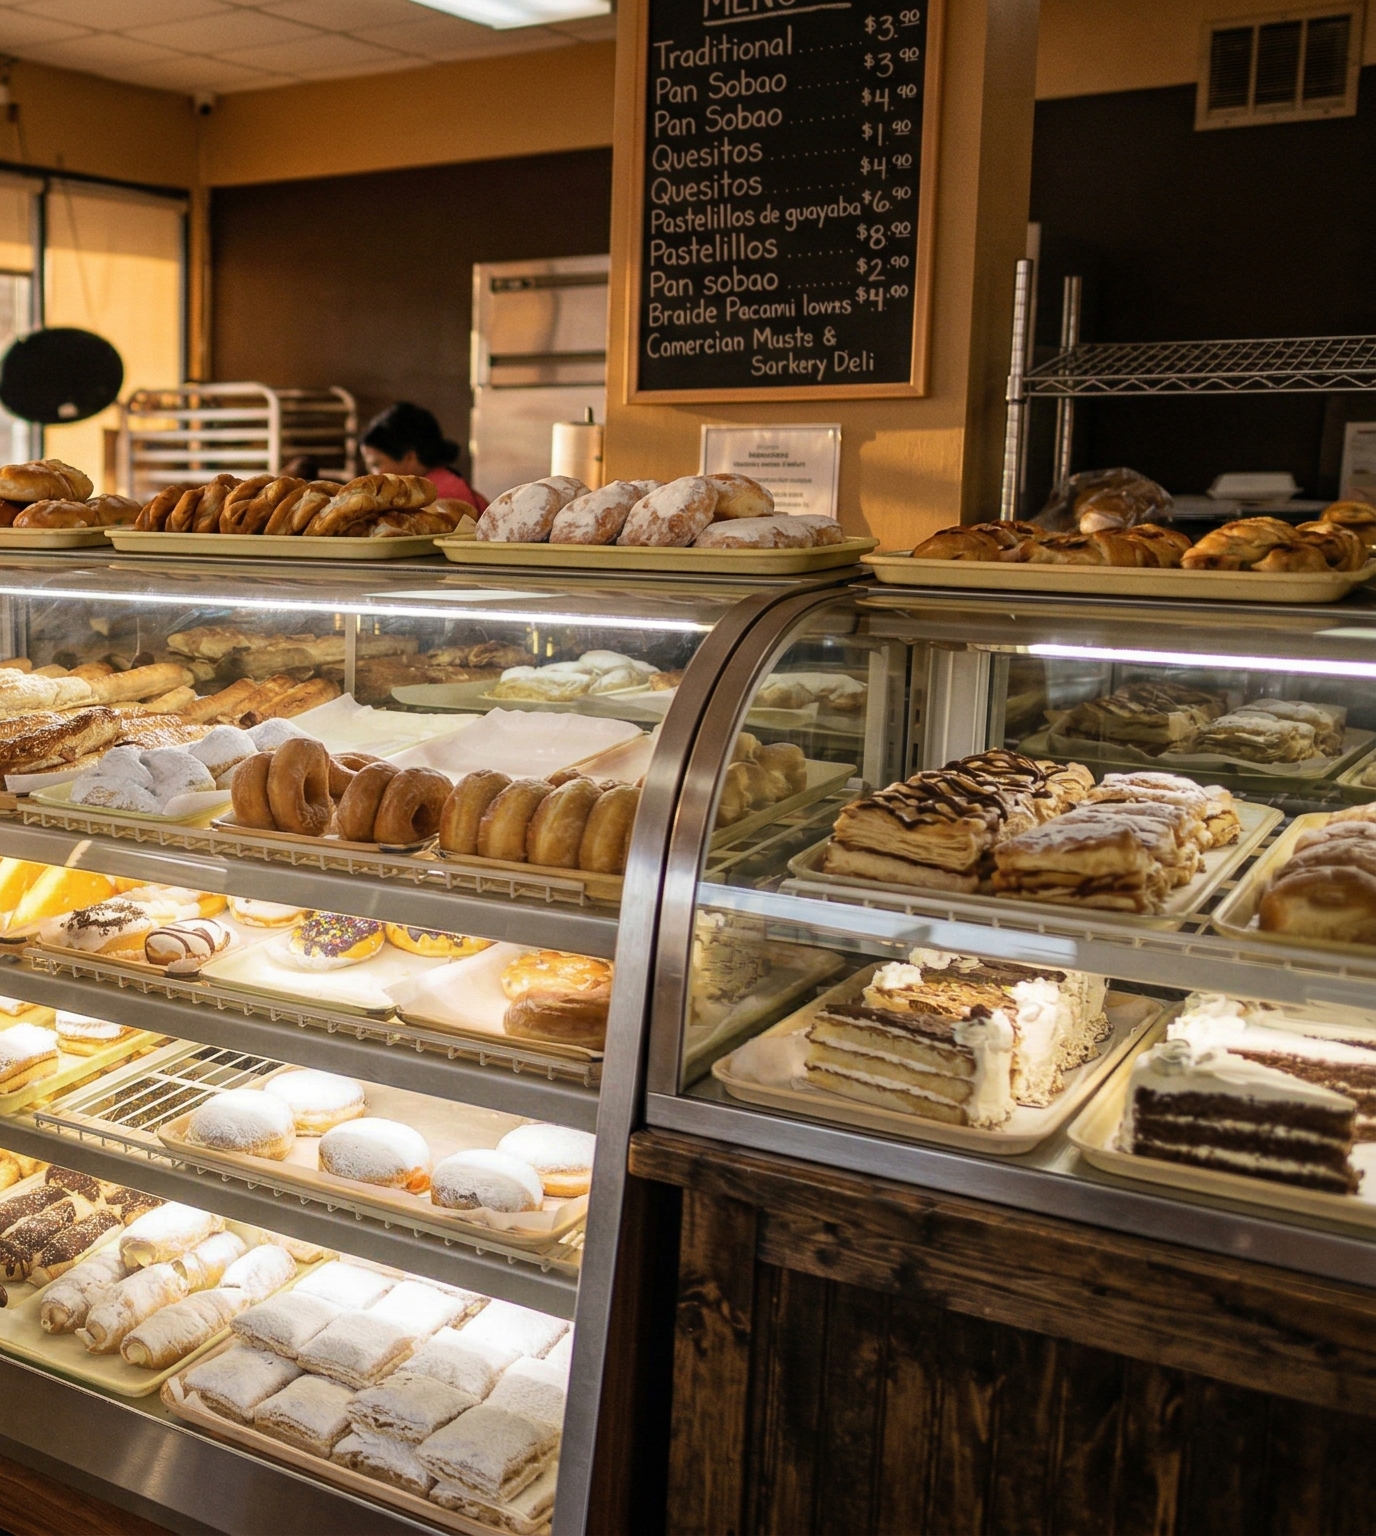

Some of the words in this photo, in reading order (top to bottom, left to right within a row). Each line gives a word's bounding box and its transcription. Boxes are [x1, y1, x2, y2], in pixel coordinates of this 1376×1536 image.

[654, 23, 792, 71] Traditional
[657, 77, 697, 104] Pan
[709, 70, 786, 99] Sobao
[655, 111, 695, 137] Pan
[706, 104, 782, 132] Sobao
[653, 137, 762, 171] Quesitos
[651, 171, 762, 205] Quesitos
[652, 204, 755, 234] Pastelillos
[760, 204, 779, 224] de
[785, 196, 861, 231] guayaba
[651, 233, 777, 266] Pastelillos
[650, 271, 693, 297] Pan
[704, 266, 778, 295] sobao
[649, 299, 717, 327] Braide
[823, 326, 836, 346] &
[834, 350, 874, 373] Deli
